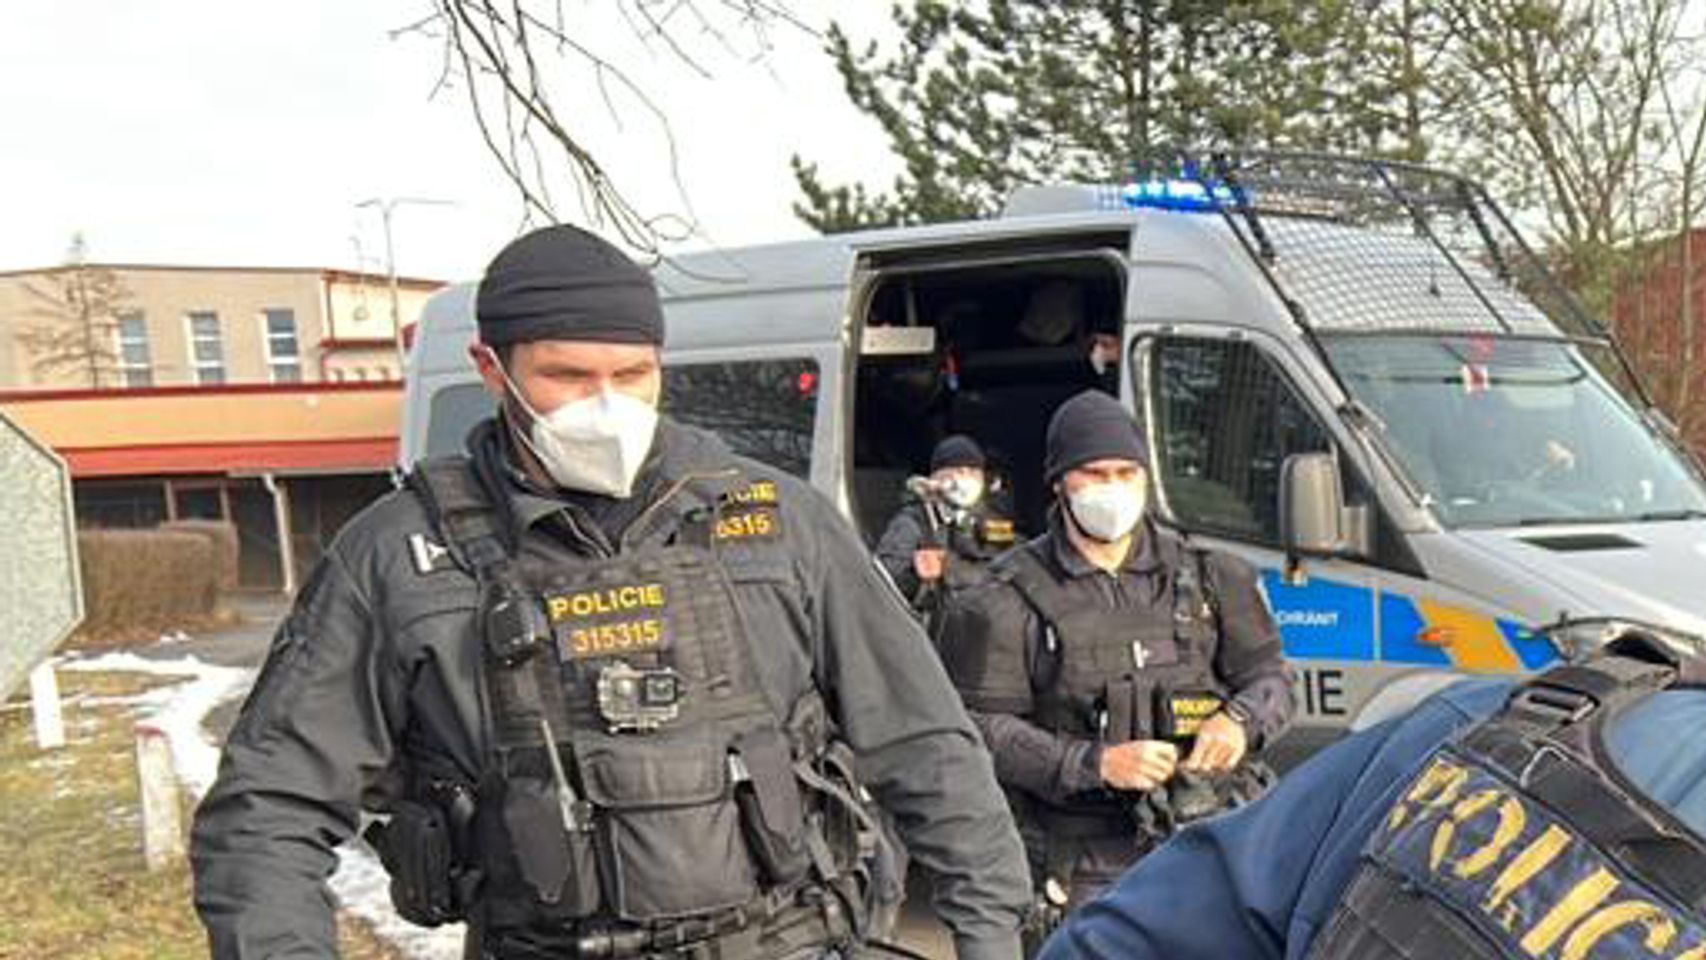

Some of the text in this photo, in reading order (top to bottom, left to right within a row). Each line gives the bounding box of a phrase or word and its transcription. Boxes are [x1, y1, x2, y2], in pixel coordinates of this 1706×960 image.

[549, 584, 664, 619] POLICIE
[571, 619, 659, 652] 315315
[1291, 670, 1346, 715] IE
